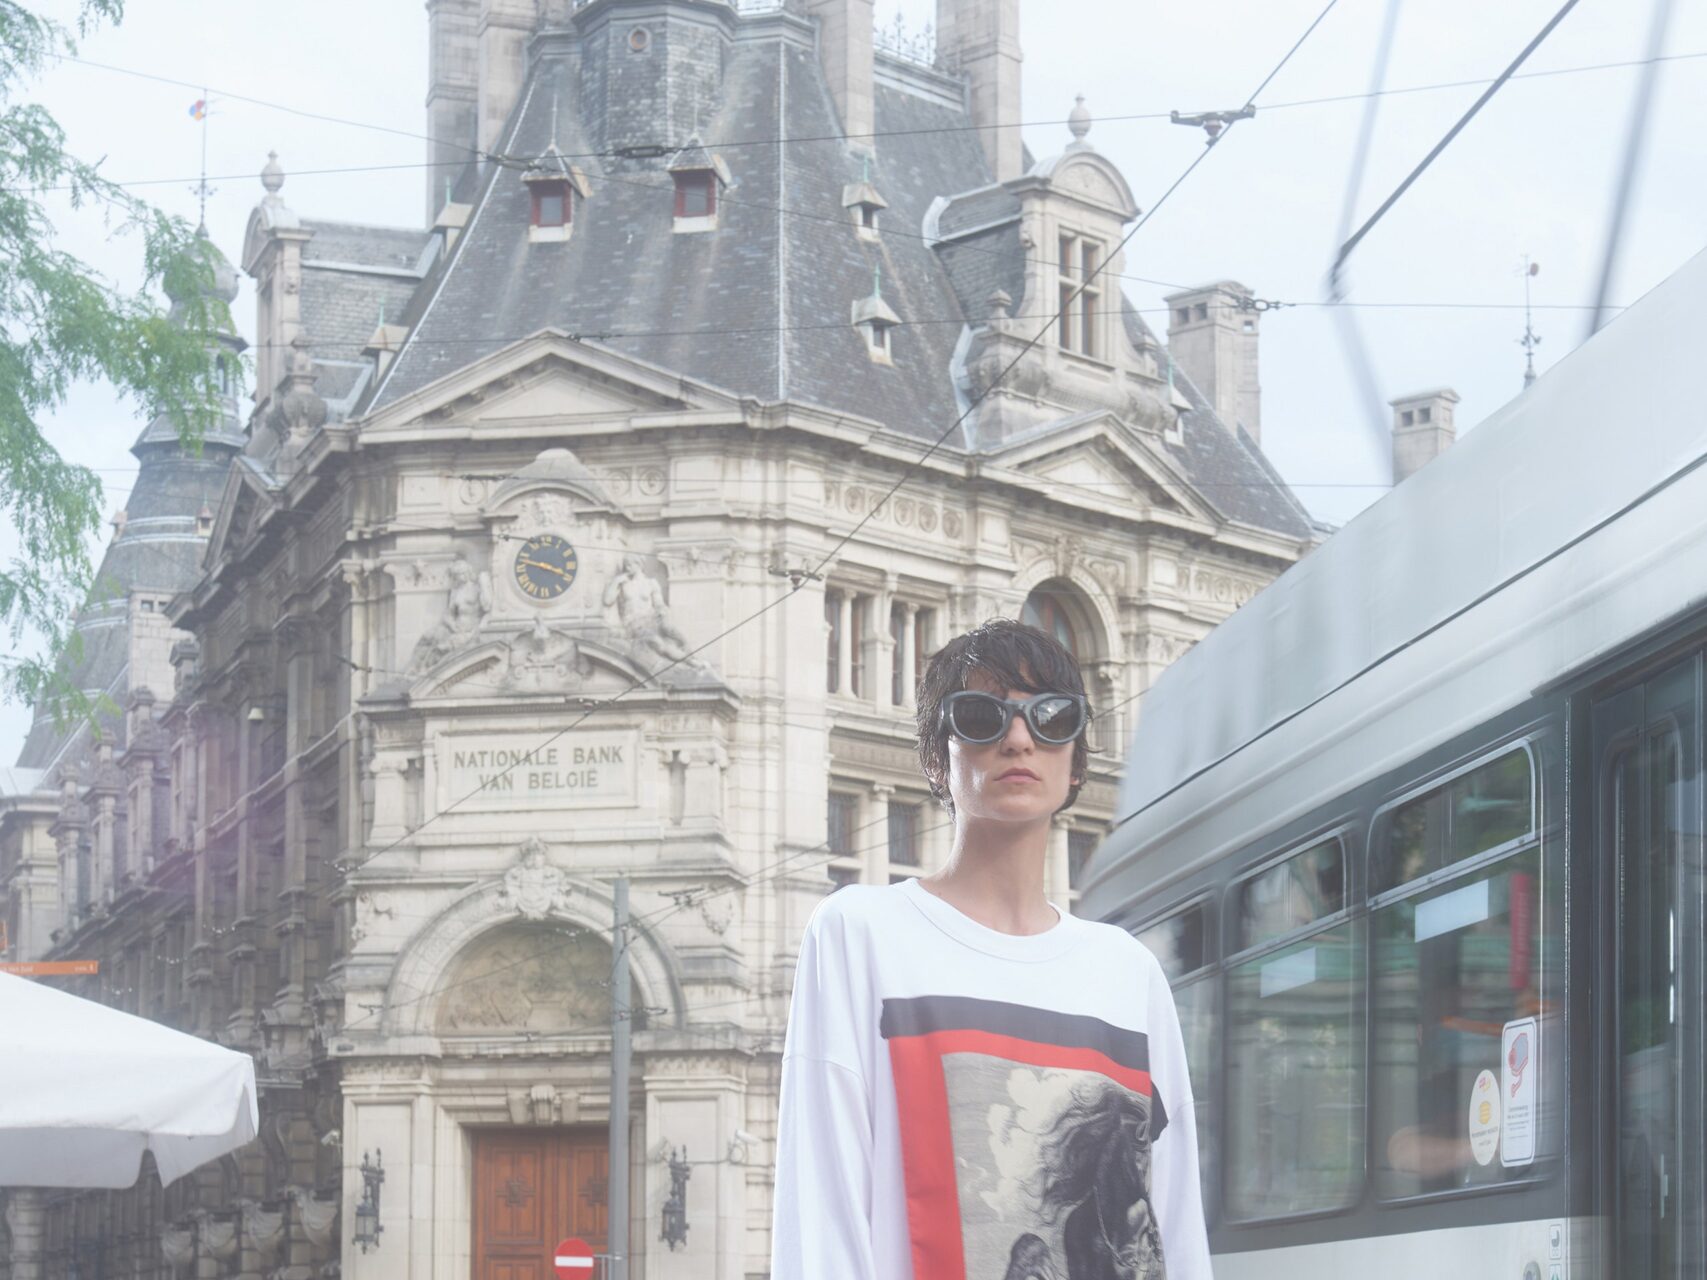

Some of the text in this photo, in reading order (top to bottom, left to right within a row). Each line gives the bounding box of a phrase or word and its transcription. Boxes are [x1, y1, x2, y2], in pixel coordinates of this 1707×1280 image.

[454, 746, 623, 769] NATIONALE BANK
[479, 773, 514, 791] VAN
